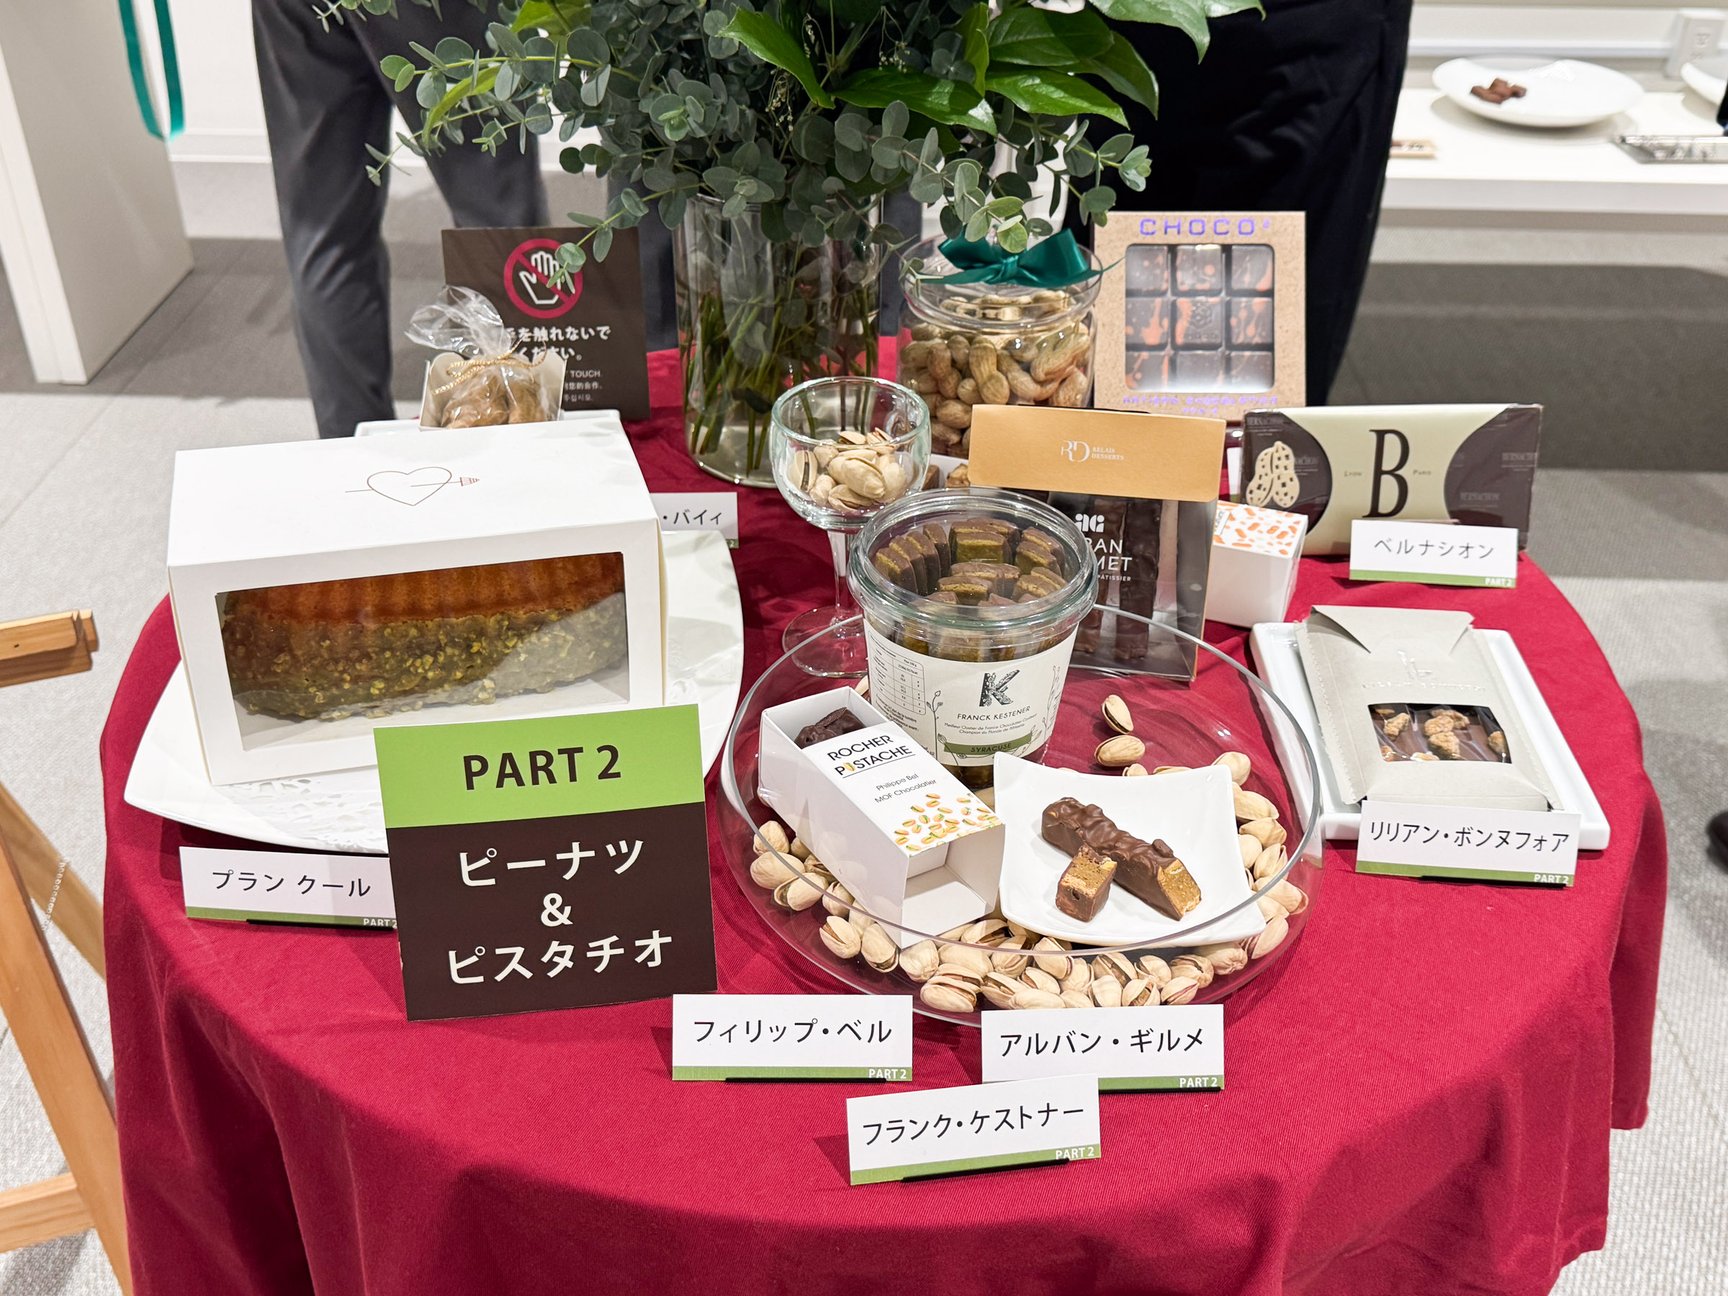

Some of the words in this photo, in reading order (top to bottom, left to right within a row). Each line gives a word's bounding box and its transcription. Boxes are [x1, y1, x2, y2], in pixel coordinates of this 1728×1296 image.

[1362, 428, 1410, 518] B
[1374, 538, 1493, 559] ベルナシオン
[1485, 577, 1506, 586] PART
[957, 713, 991, 721] FRANCK
[993, 705, 1031, 720] KESTENER
[827, 735, 894, 761] ROCHER
[970, 743, 1013, 753] SYRACUSE
[462, 746, 584, 791] PART
[597, 744, 622, 781] 2
[874, 793, 894, 803] MOF
[893, 779, 937, 796] Chocolatier
[875, 777, 906, 791] Philippe
[906, 773, 919, 782] Bel
[1370, 821, 1570, 852] リリアン・ボンヌフォア
[459, 838, 645, 887] ピーナツ
[212, 868, 284, 892] プラン
[297, 875, 371, 897] クール
[1533, 873, 1560, 884] PART
[1562, 875, 1569, 884] 2
[539, 892, 574, 927] &
[363, 918, 390, 927] PART
[392, 920, 398, 928] 2
[448, 929, 673, 985] ピスタチオ
[694, 1018, 892, 1044] フィリップ・ベル
[999, 1027, 1204, 1058] アルバン・ギルメ
[868, 1068, 897, 1079] PART
[899, 1069, 907, 1079] 2
[1179, 1077, 1207, 1088] PART
[1209, 1077, 1218, 1087] 2
[862, 1102, 1085, 1146] フランク・ケストナー
[1055, 1148, 1085, 1161] PART
[1086, 1147, 1095, 1157] 2
